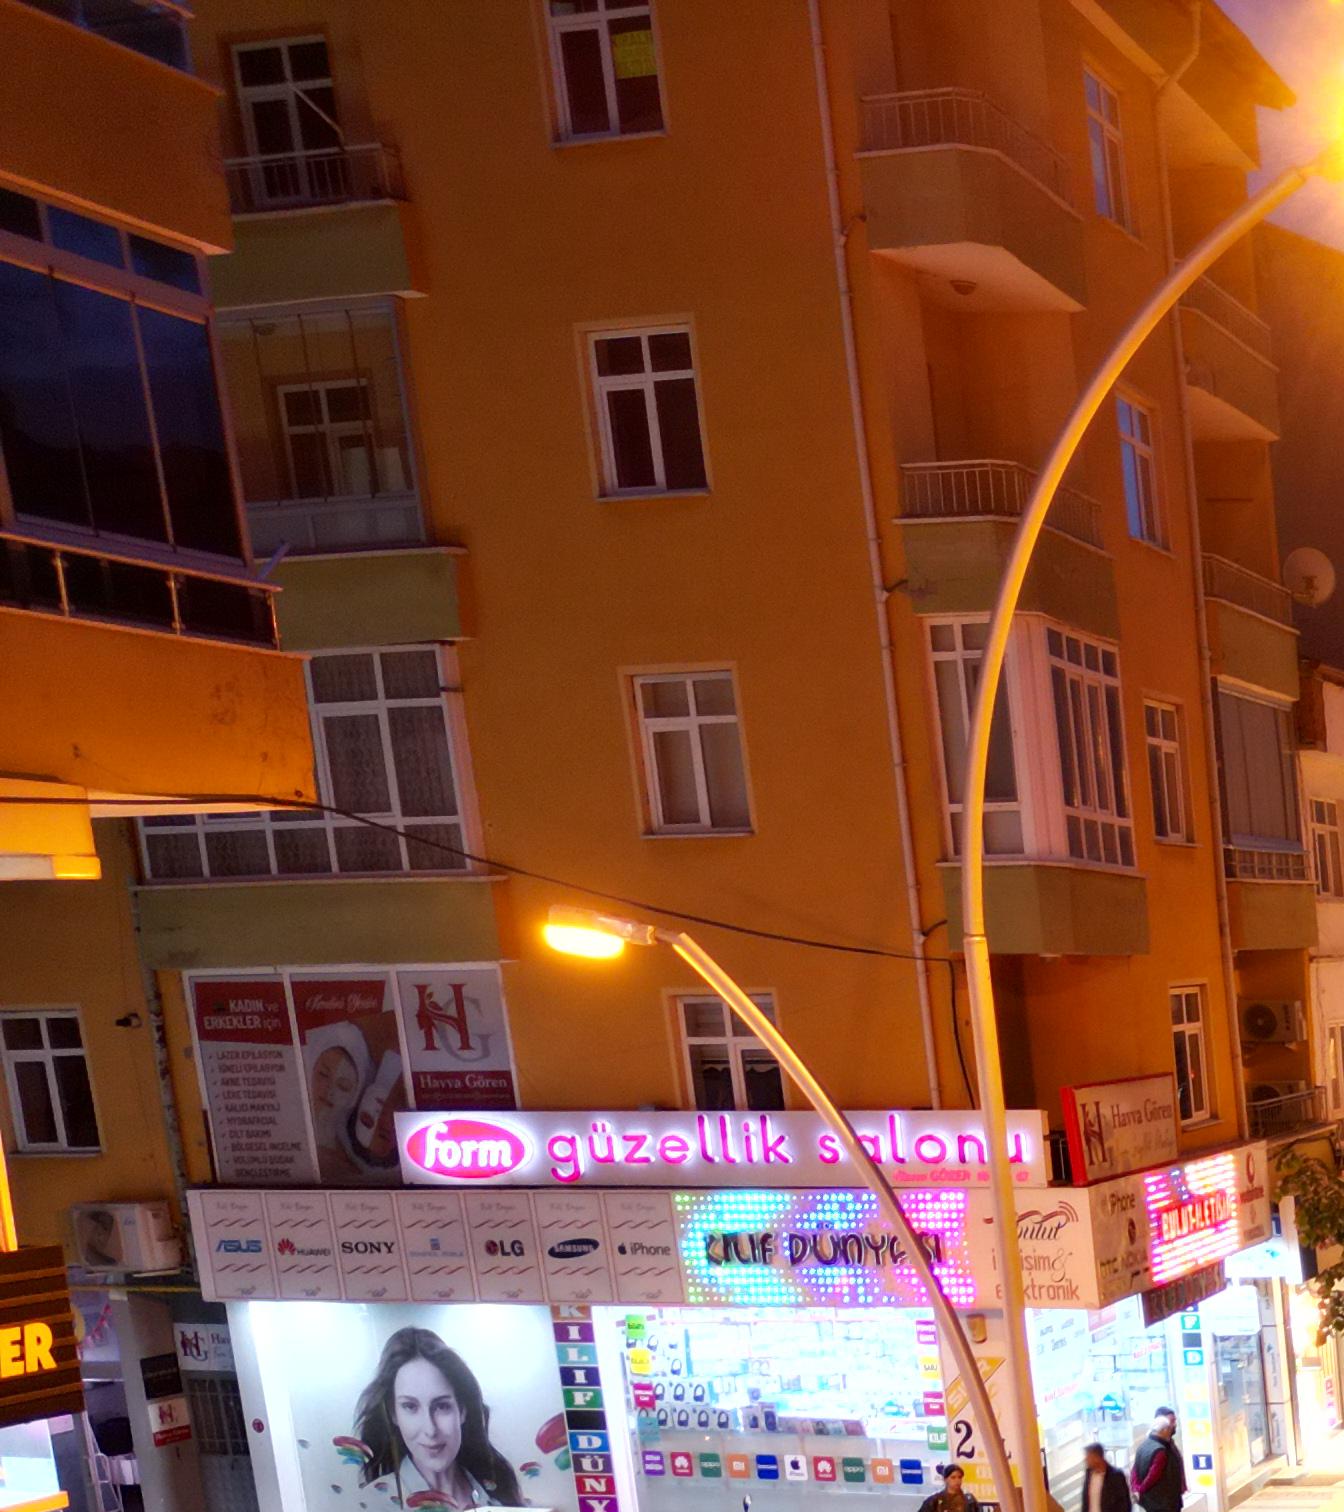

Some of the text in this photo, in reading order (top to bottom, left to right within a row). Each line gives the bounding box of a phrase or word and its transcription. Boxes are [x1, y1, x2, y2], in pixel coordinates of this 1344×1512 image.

[228, 999, 264, 1012] KADIN
[204, 1015, 262, 1030] ERKEKLER
[419, 1073, 508, 1089] Havva Gören
[1111, 1098, 1173, 1128] Havva Gören
[424, 1122, 513, 1169] form
[547, 1114, 790, 1183] güzellik
[216, 1240, 263, 1253] ASUS
[341, 1241, 395, 1254] SONY
[501, 1240, 525, 1257] LG
[553, 1243, 594, 1254] SAMSUNG
[630, 1242, 671, 1256] iPhone
